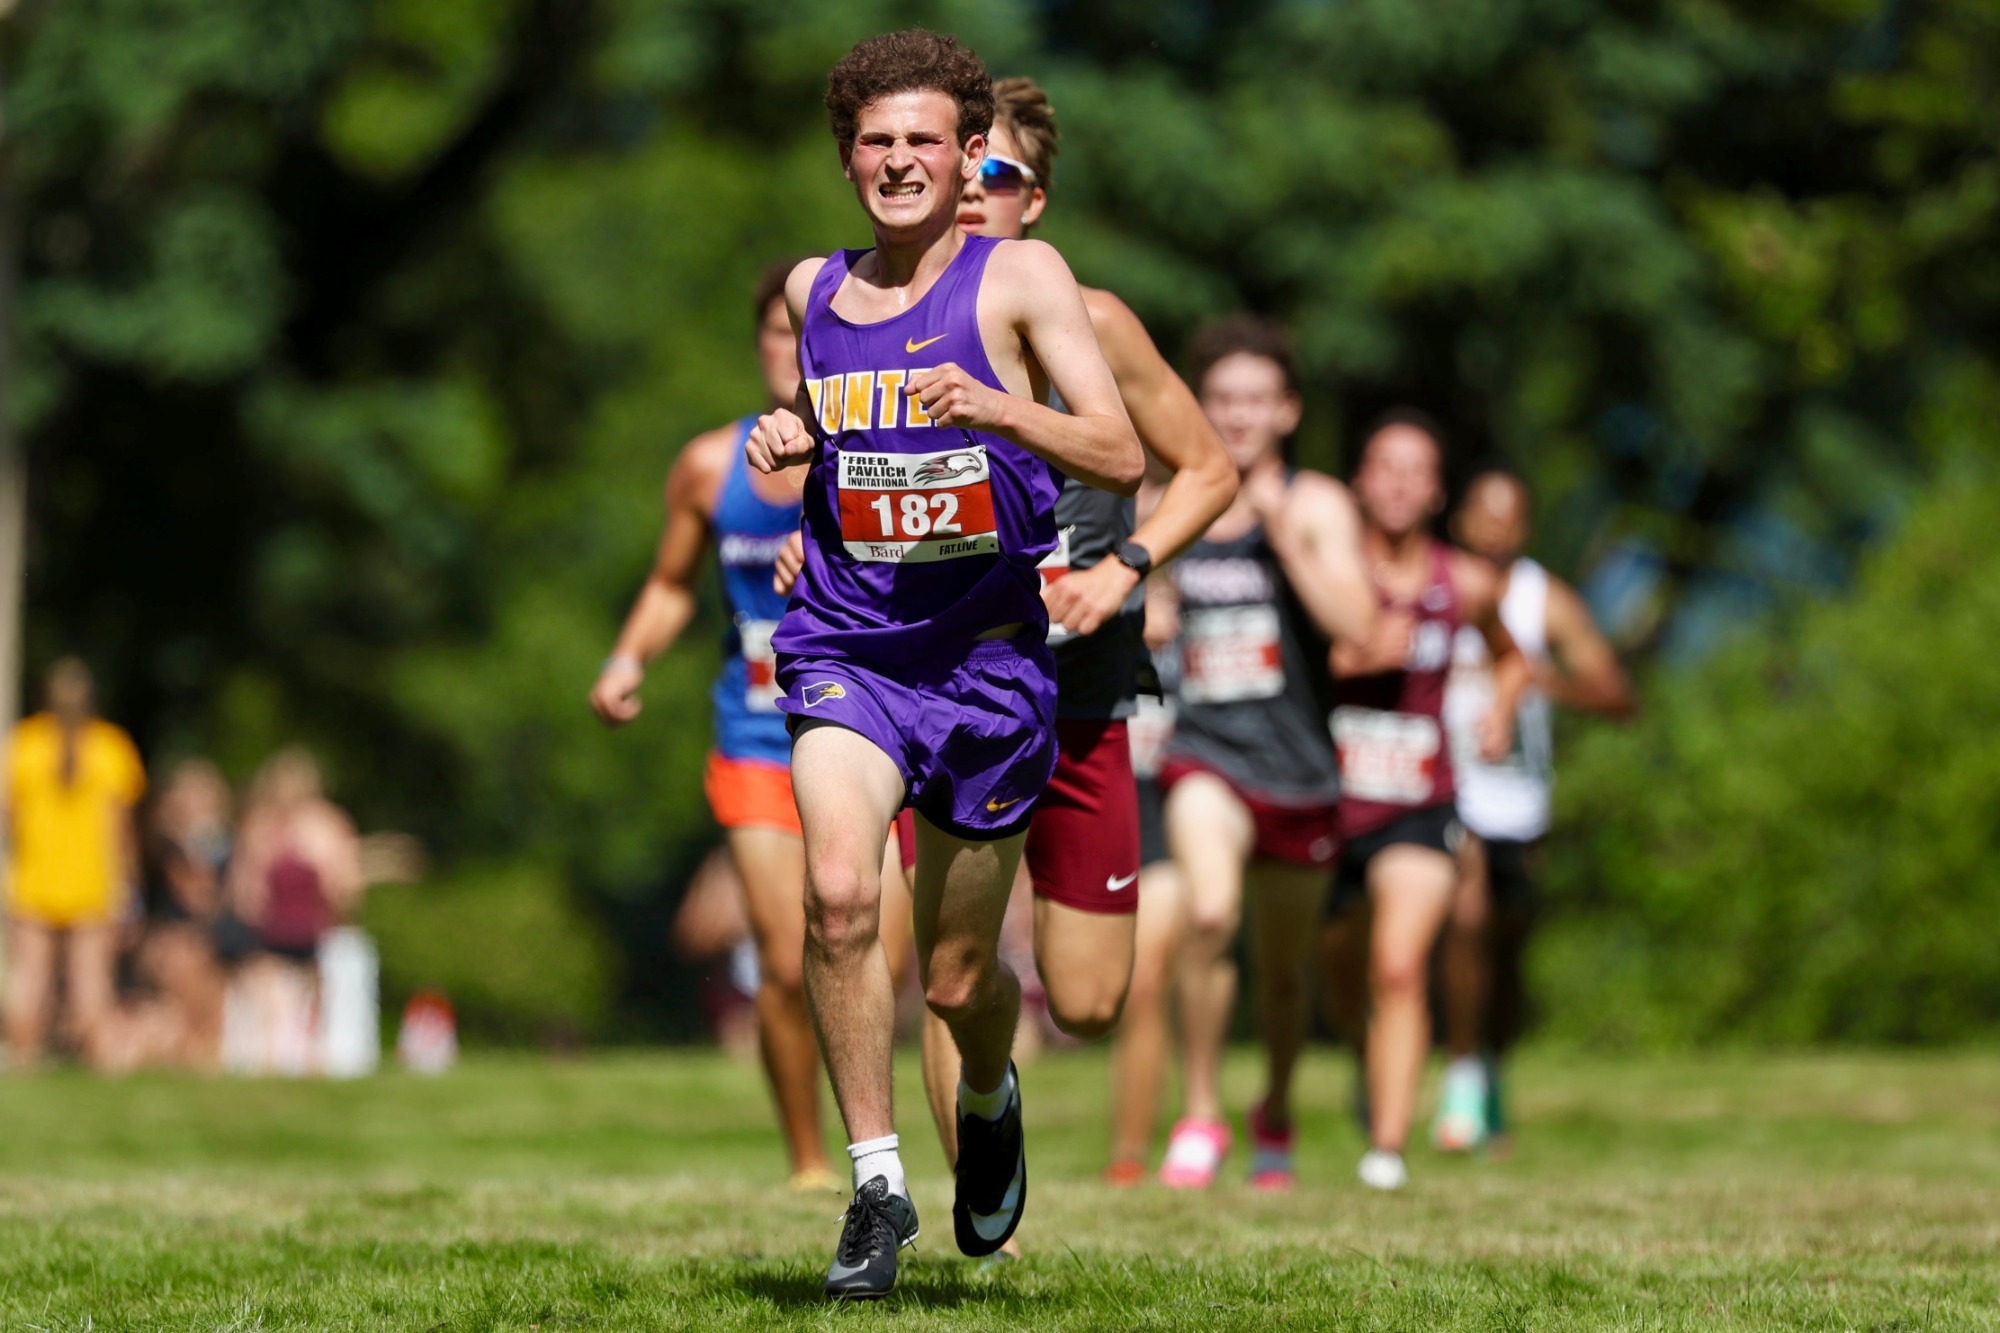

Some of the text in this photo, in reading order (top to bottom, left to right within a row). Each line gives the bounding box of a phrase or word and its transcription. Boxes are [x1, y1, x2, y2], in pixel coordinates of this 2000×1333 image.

[805, 368, 939, 435] UNTE
[848, 456, 889, 466] FRED
[847, 465, 907, 478] PAVLICH
[848, 477, 909, 487] INVITATIONAL
[870, 492, 962, 537] 182
[870, 545, 906, 559] Bard
[939, 541, 978, 556] FAT.LIVE
